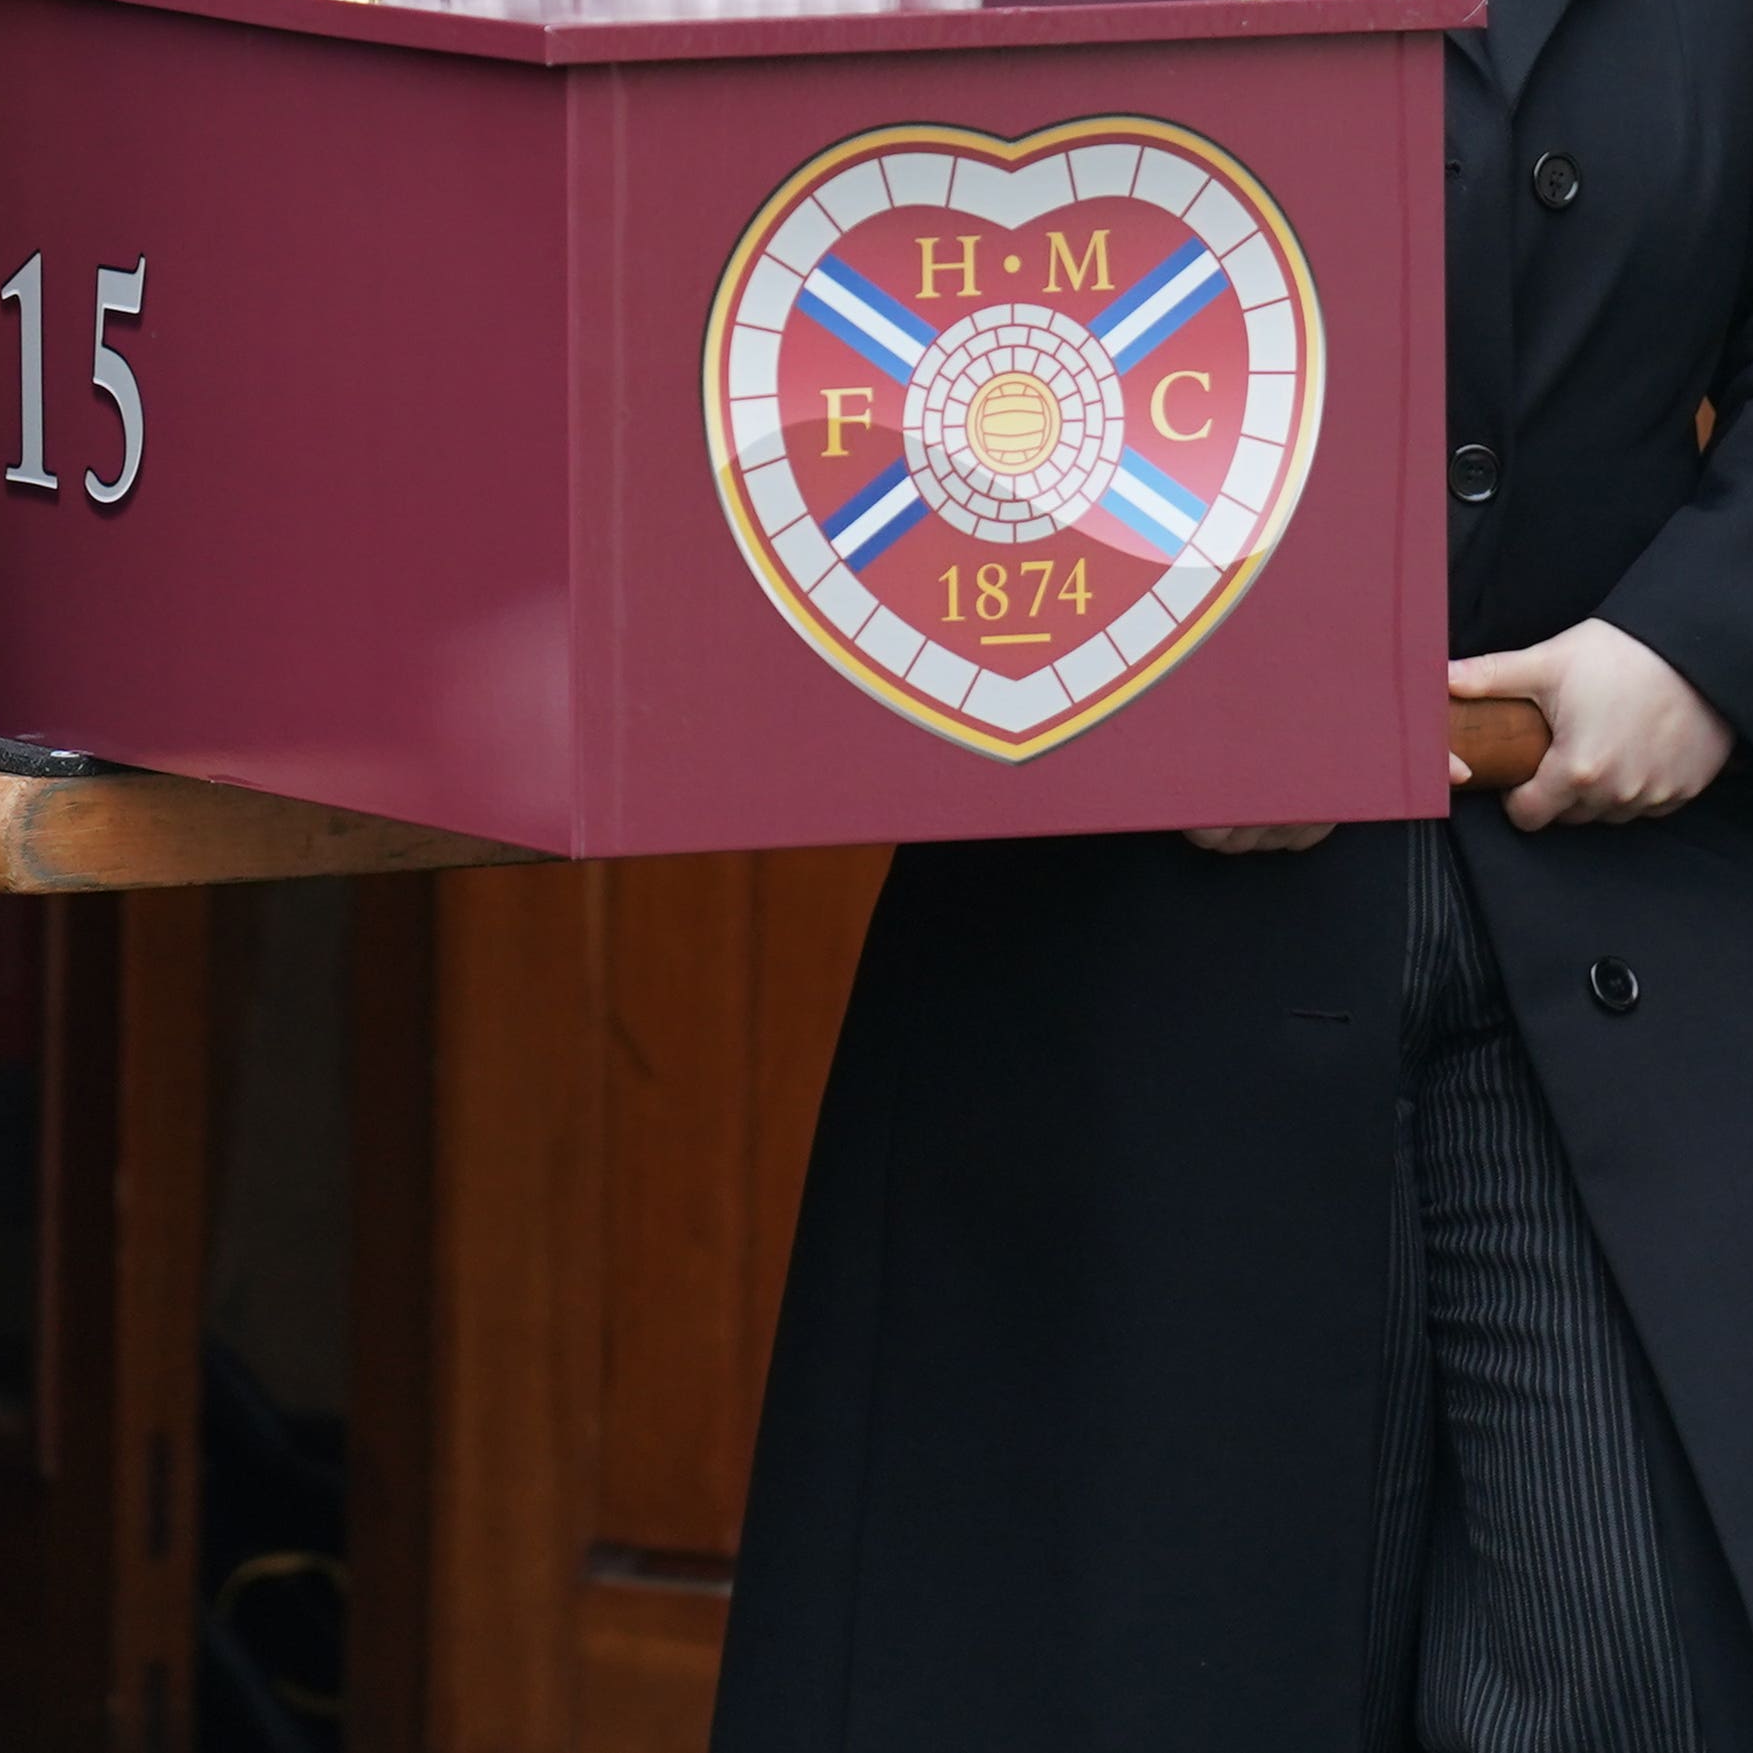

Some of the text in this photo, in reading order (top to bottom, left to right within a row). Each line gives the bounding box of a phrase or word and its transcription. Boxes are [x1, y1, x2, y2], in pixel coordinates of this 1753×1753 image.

[819, 386, 875, 458] F
[1149, 369, 1213, 442] C
[938, 557, 1093, 622] 1874
